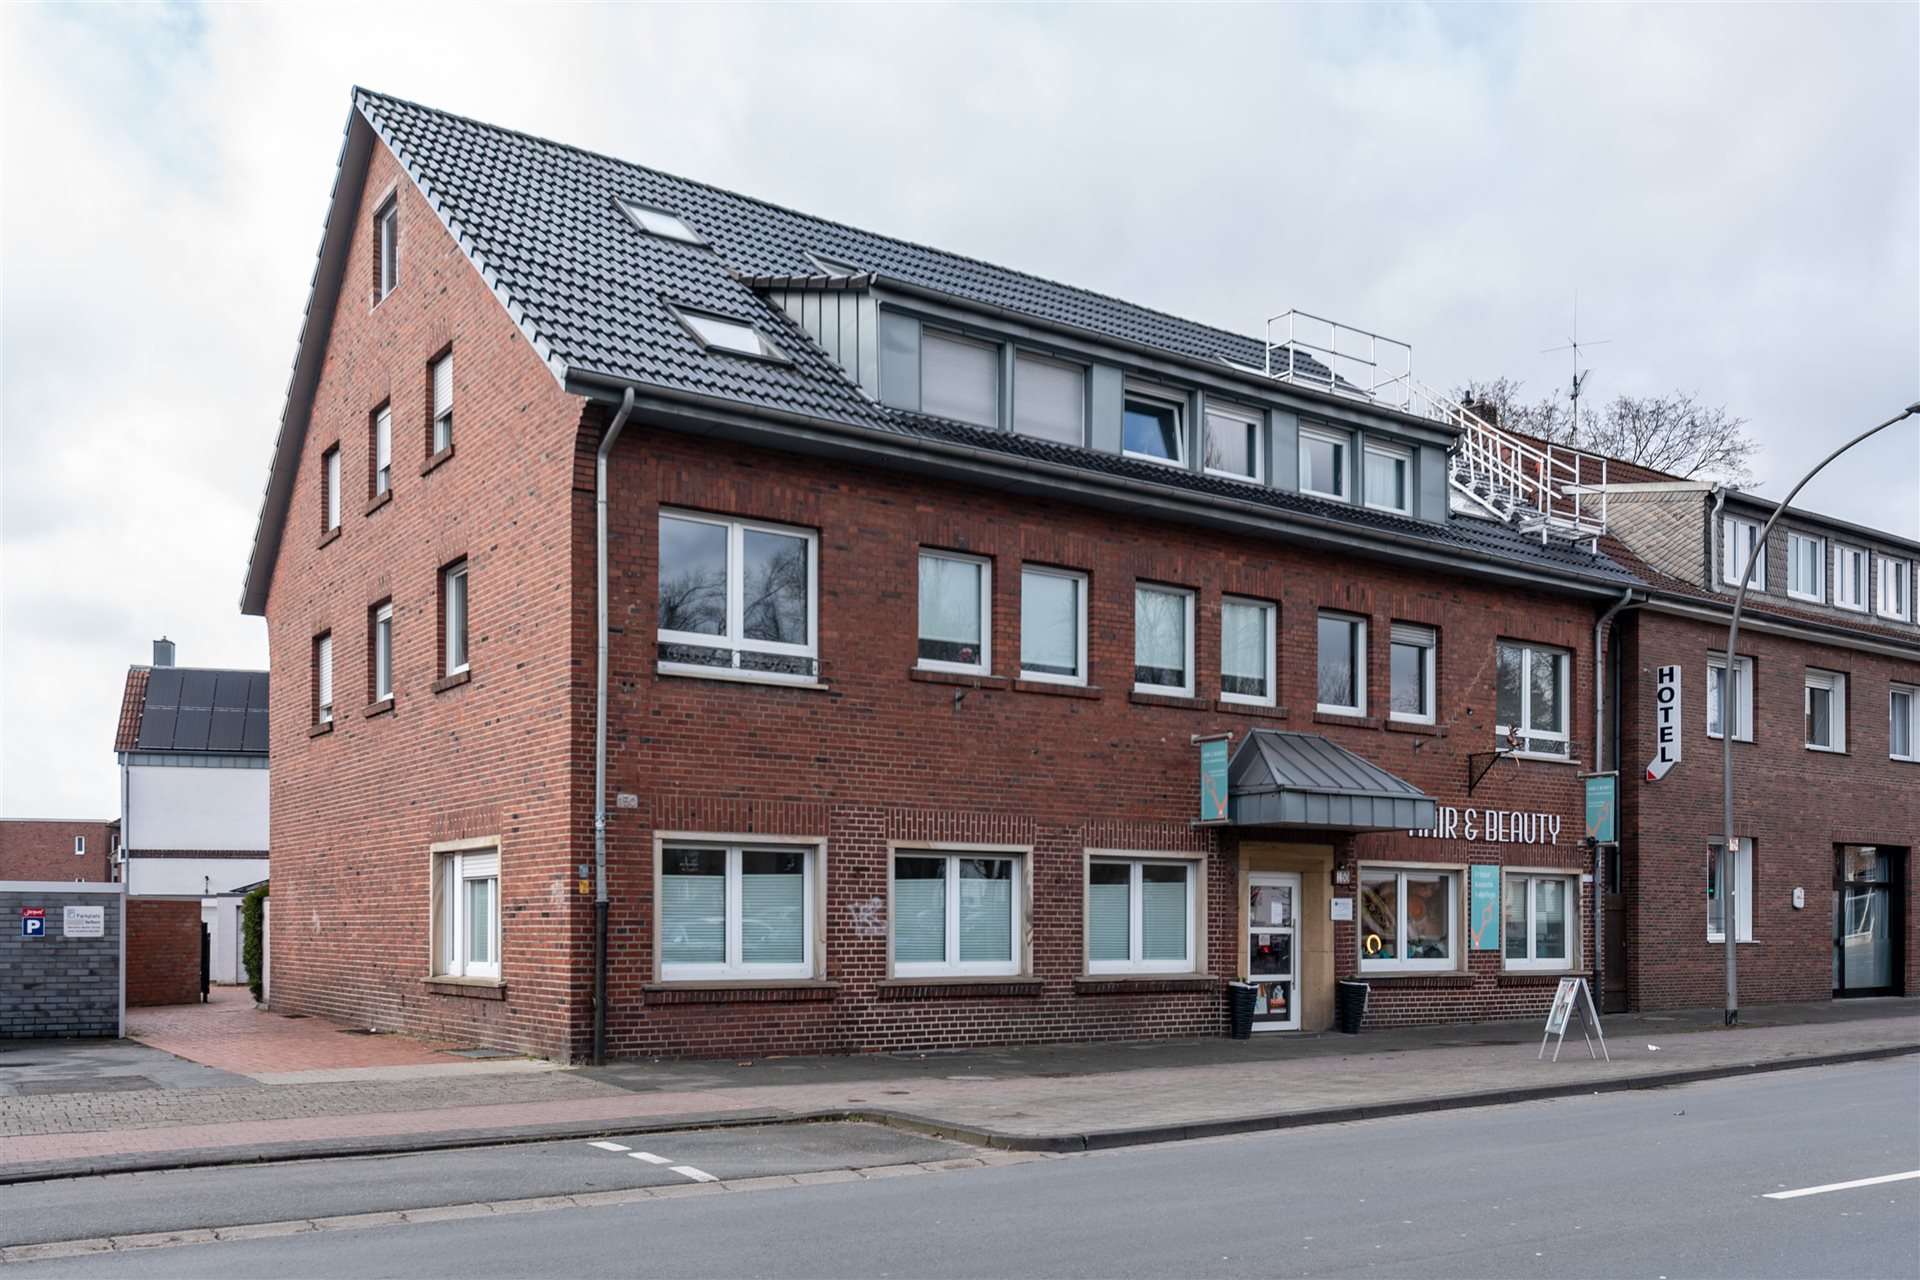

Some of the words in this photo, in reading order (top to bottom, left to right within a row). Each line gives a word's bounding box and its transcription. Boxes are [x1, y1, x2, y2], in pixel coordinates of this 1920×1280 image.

[1657, 666, 1675, 763] HOTEL
[1408, 806, 1458, 840] IR
[1464, 807, 1479, 841] &
[1485, 809, 1561, 845] BEAUTY
[26, 919, 41, 934] P
